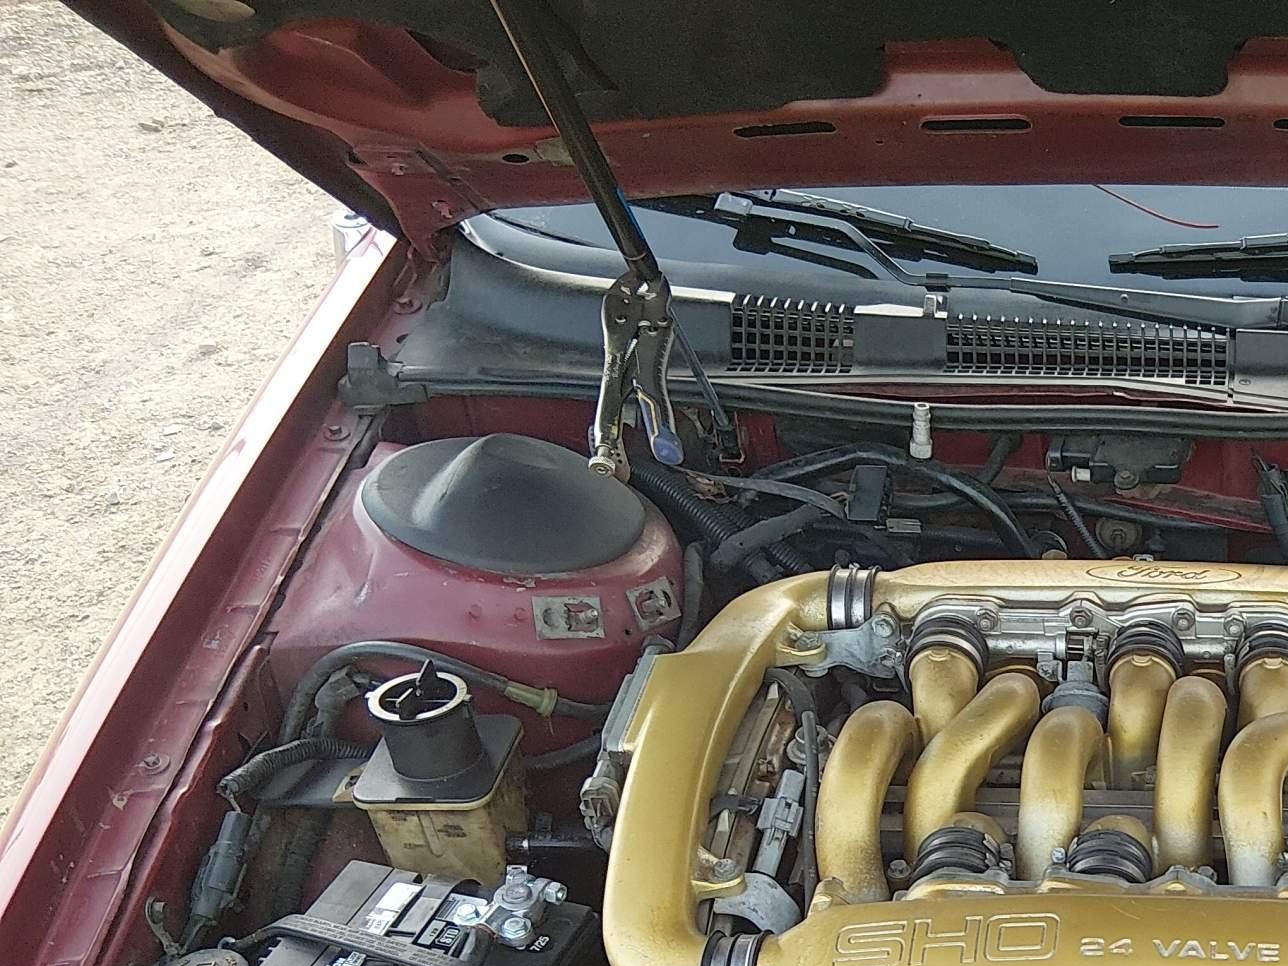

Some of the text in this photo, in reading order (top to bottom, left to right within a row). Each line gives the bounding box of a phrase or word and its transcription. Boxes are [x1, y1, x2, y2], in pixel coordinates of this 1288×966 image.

[1117, 565, 1211, 580] Ford
[529, 934, 550, 952] 7/25
[1080, 937, 1133, 955] 24
[1152, 939, 1280, 962] VALVE
